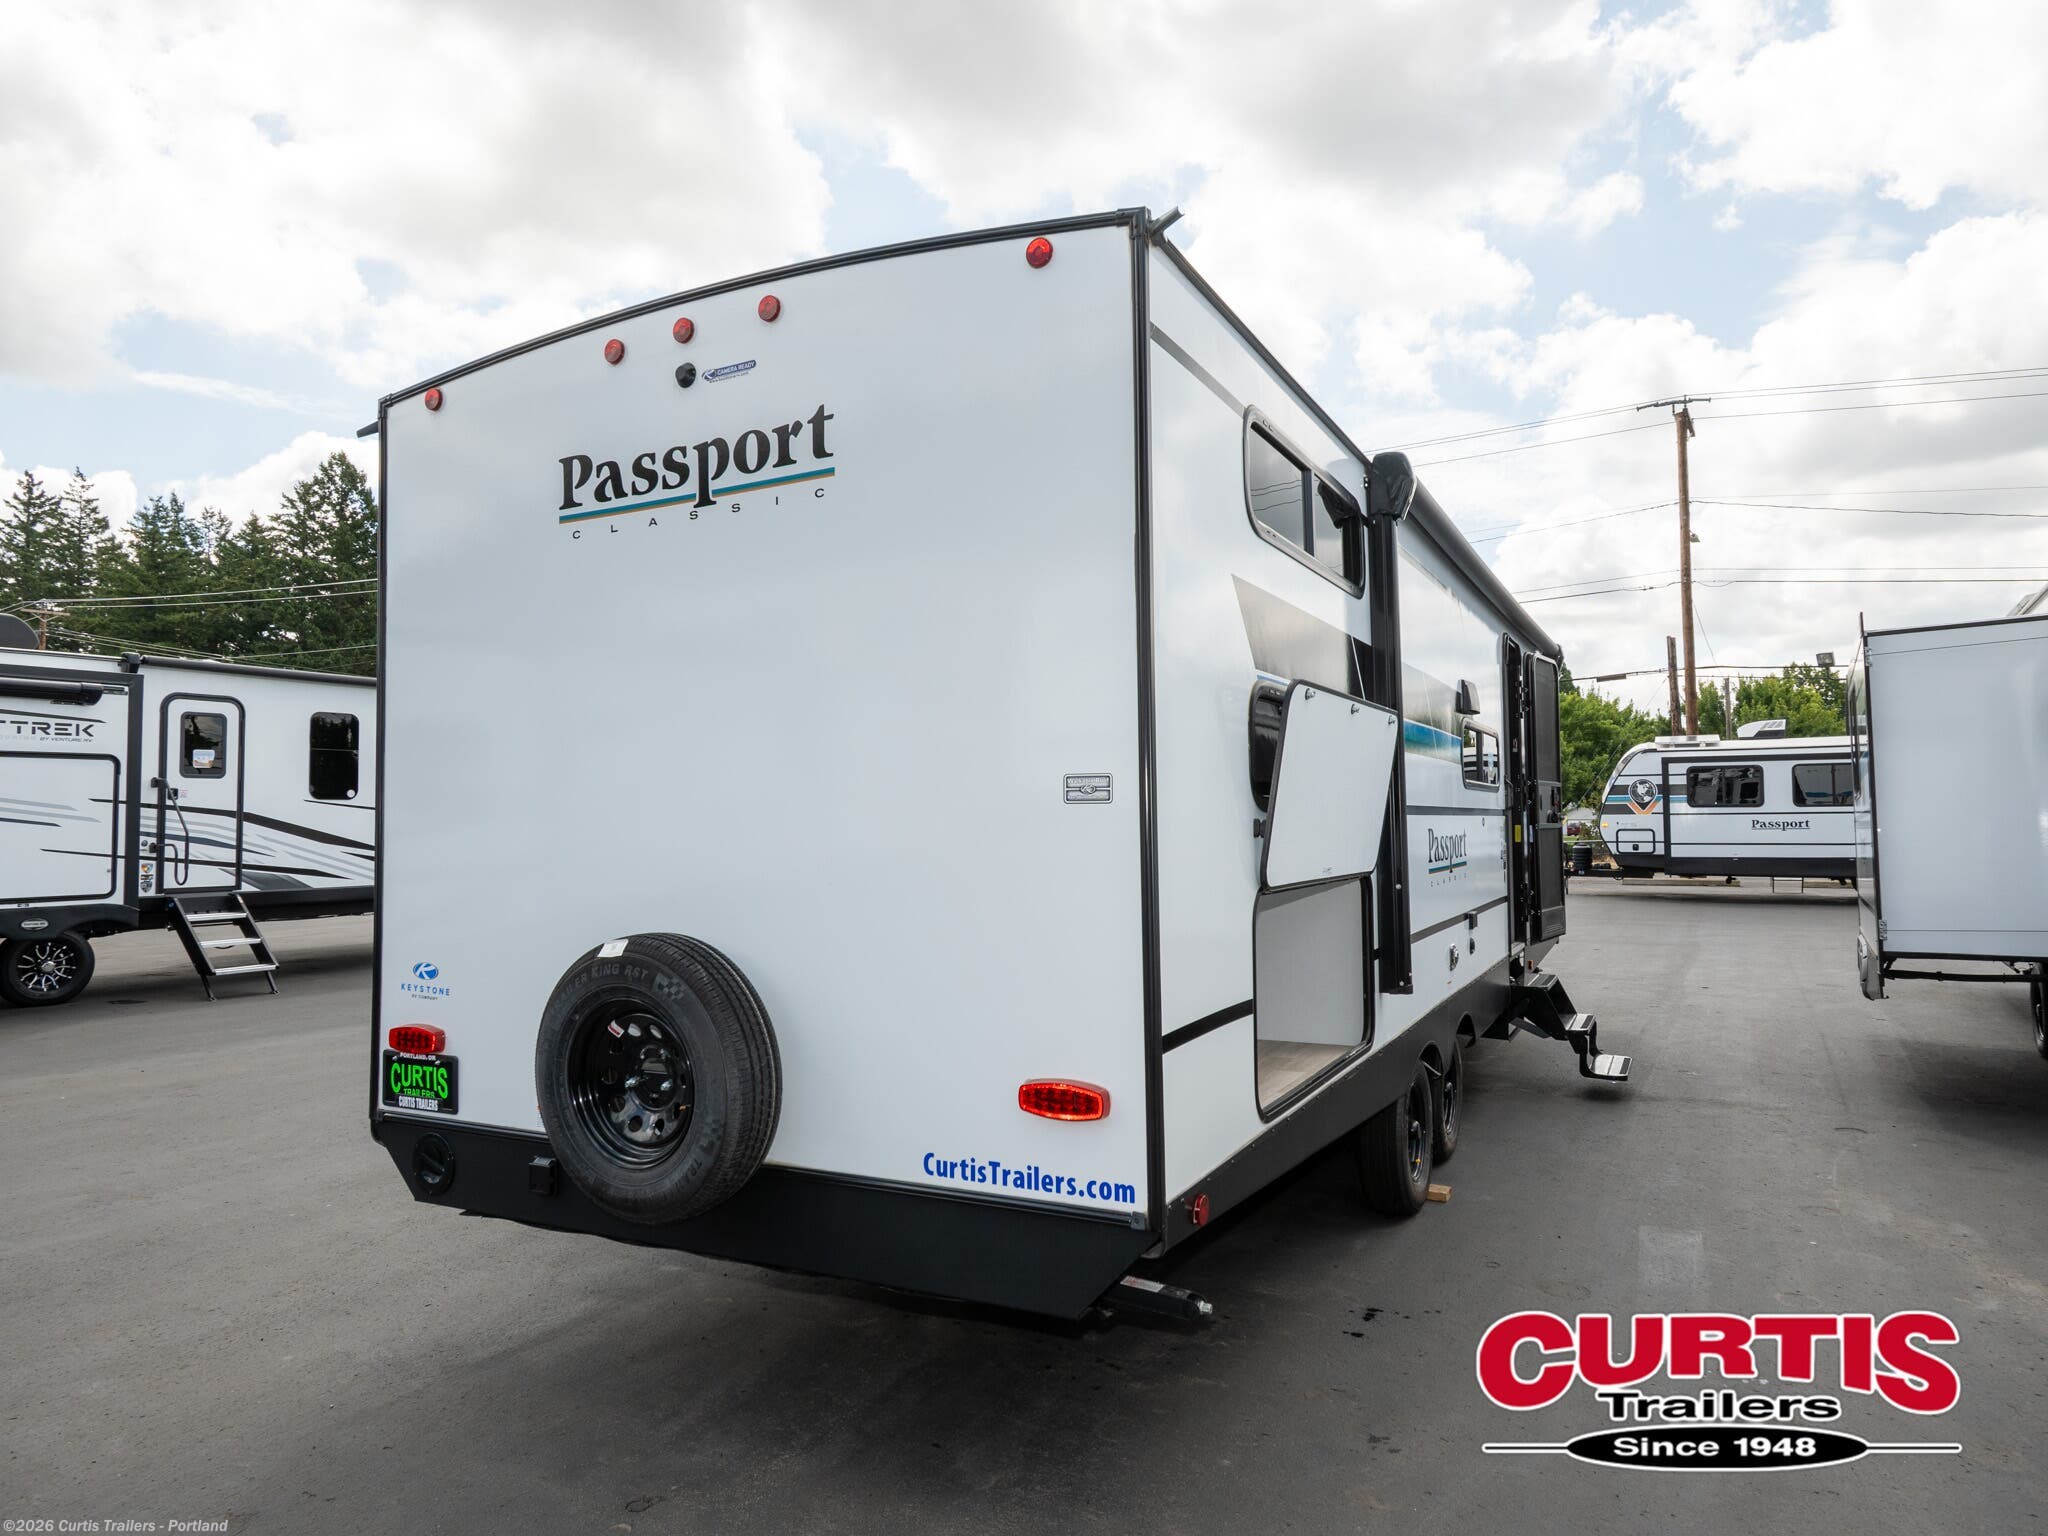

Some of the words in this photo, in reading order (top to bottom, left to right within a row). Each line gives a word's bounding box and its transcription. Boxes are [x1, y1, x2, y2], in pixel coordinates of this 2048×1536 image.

[716, 365, 738, 376] CAMERA
[738, 360, 756, 370] READY
[559, 404, 834, 510] Passport
[572, 487, 825, 540] CLASSIC
[1751, 819, 1810, 831] Passport
[1428, 827, 1467, 873] Passport
[592, 963, 620, 978] KING
[624, 964, 649, 981] RST
[401, 983, 451, 997] KEYSTONE
[391, 1063, 448, 1099] CURTIS
[398, 1095, 416, 1109] CURTIS
[416, 1097, 438, 1111] TRAILERS
[404, 1089, 436, 1099] TRAILERS
[923, 1152, 1135, 1204] CurtisTrailers.com
